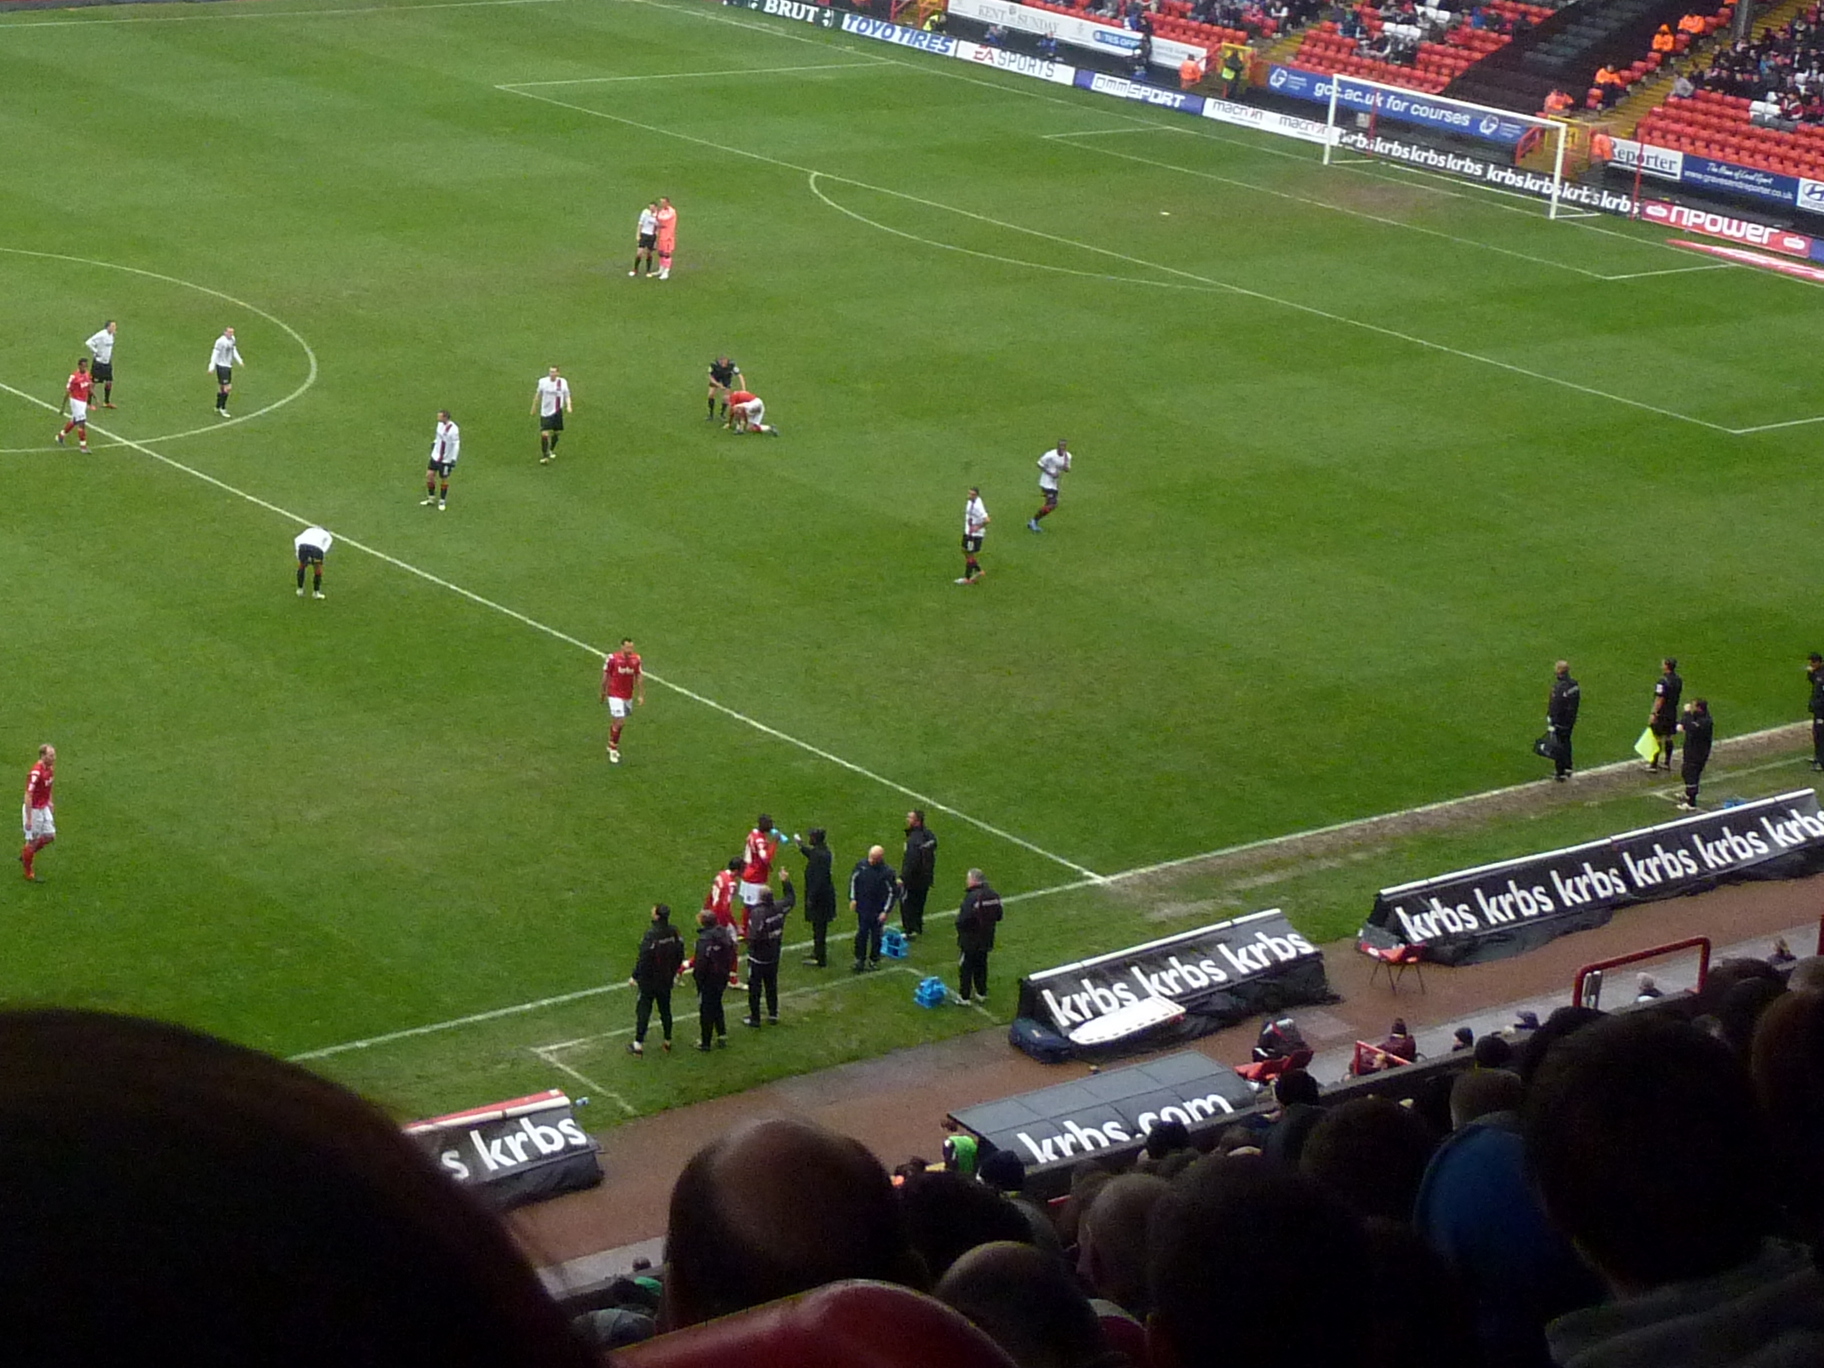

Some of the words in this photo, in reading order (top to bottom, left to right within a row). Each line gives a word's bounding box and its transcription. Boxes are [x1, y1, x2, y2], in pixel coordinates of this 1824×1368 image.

[845, 14, 895, 43] TOYO
[897, 26, 953, 54] TIRES
[973, 45, 996, 65] EA
[997, 50, 1056, 78] SPORTS
[1386, 95, 1409, 113] for
[1410, 102, 1471, 127] courses
[1374, 136, 1410, 159] krbs
[1411, 143, 1447, 167] krbs
[1446, 152, 1483, 177] krbs
[1487, 163, 1525, 189] krbs
[1601, 189, 1640, 215] krbs
[1396, 898, 1478, 943] krbs
[1474, 880, 1555, 925] krbs
[1550, 862, 1627, 908] krbs
[1622, 844, 1698, 889] krbs
[1693, 827, 1770, 871] krbs
[1042, 978, 1140, 1028] krbs
[1131, 956, 1228, 1002] krbs
[1218, 931, 1315, 976] krbs
[470, 1116, 588, 1172] krbs
